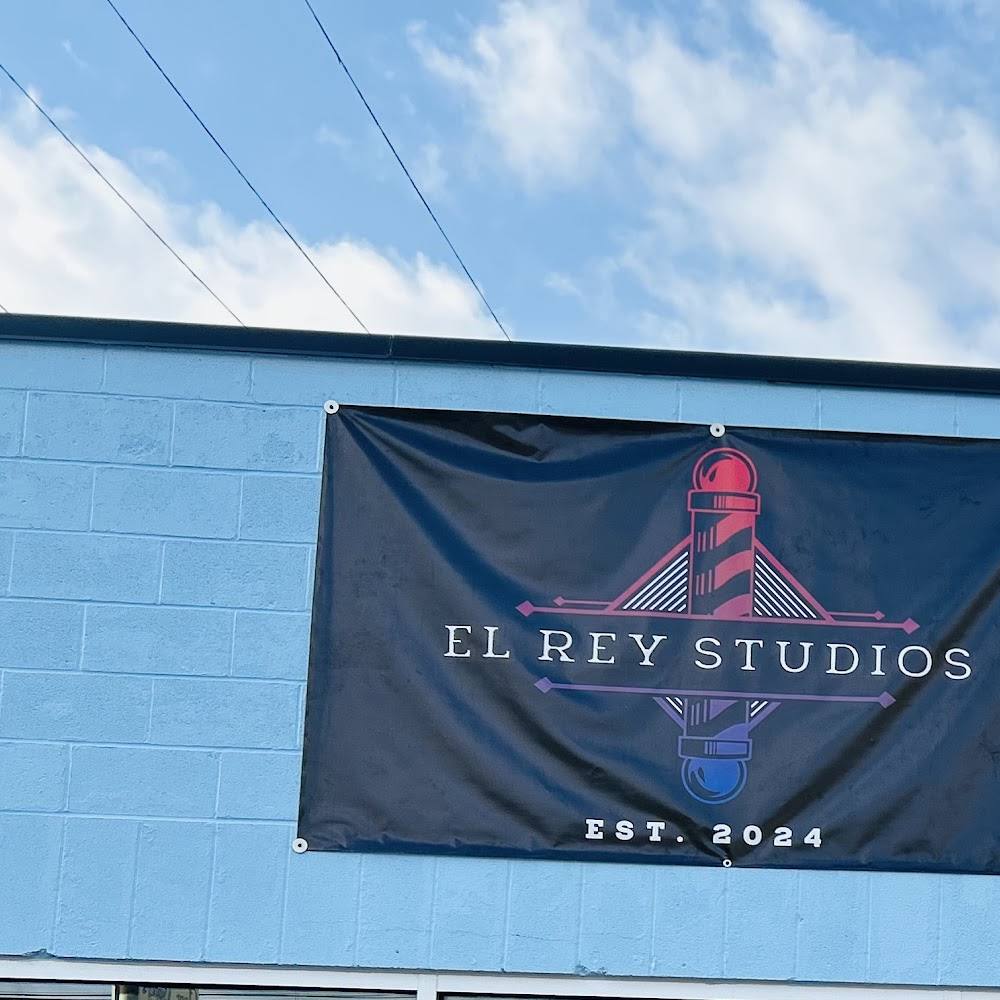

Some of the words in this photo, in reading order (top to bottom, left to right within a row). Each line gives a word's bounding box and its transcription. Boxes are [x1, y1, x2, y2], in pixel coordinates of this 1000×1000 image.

[443, 624, 510, 660] EL
[538, 628, 668, 667] REY
[693, 636, 973, 680] STUDIOS
[585, 818, 684, 843] EST.
[712, 823, 822, 848] 2024
